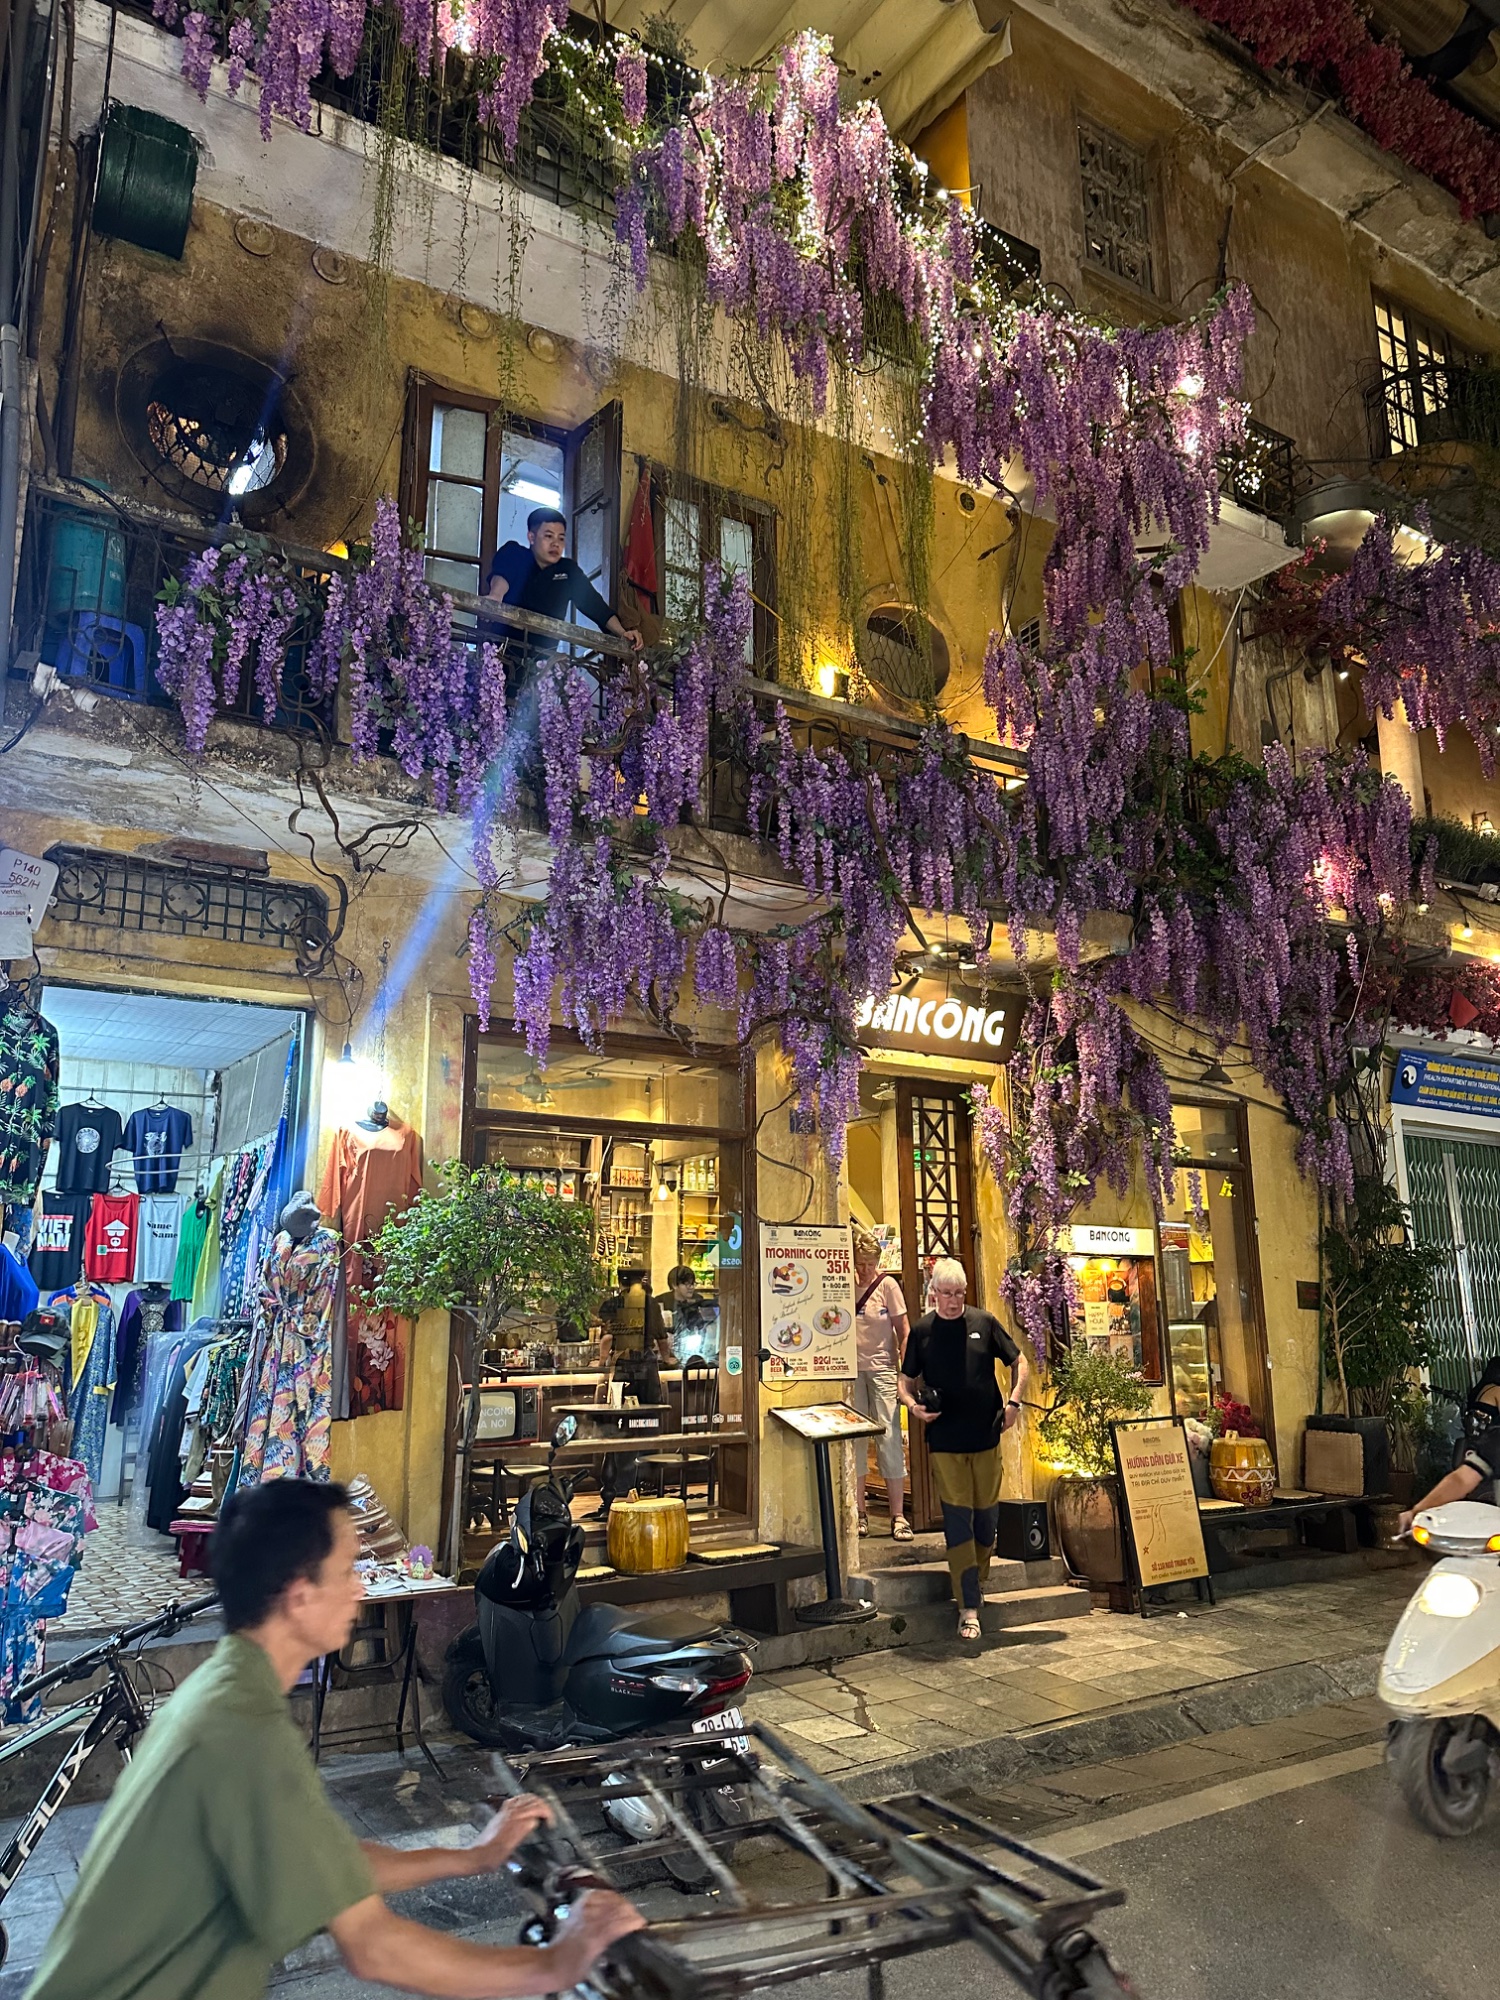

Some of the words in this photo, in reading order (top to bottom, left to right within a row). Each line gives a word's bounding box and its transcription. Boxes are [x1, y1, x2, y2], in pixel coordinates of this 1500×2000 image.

[38, 1218, 73, 1234] VIET
[146, 1220, 172, 1230] Same
[37, 1232, 70, 1248] NAM
[152, 1231, 178, 1239] Same
[1090, 1230, 1130, 1242] BANCONG
[766, 1248, 812, 1259] MORNING
[814, 1249, 849, 1259] COFFEE
[826, 1260, 850, 1274] 35K
[480, 1406, 514, 1416] NCONG
[1176, 1453, 1184, 1463] XE
